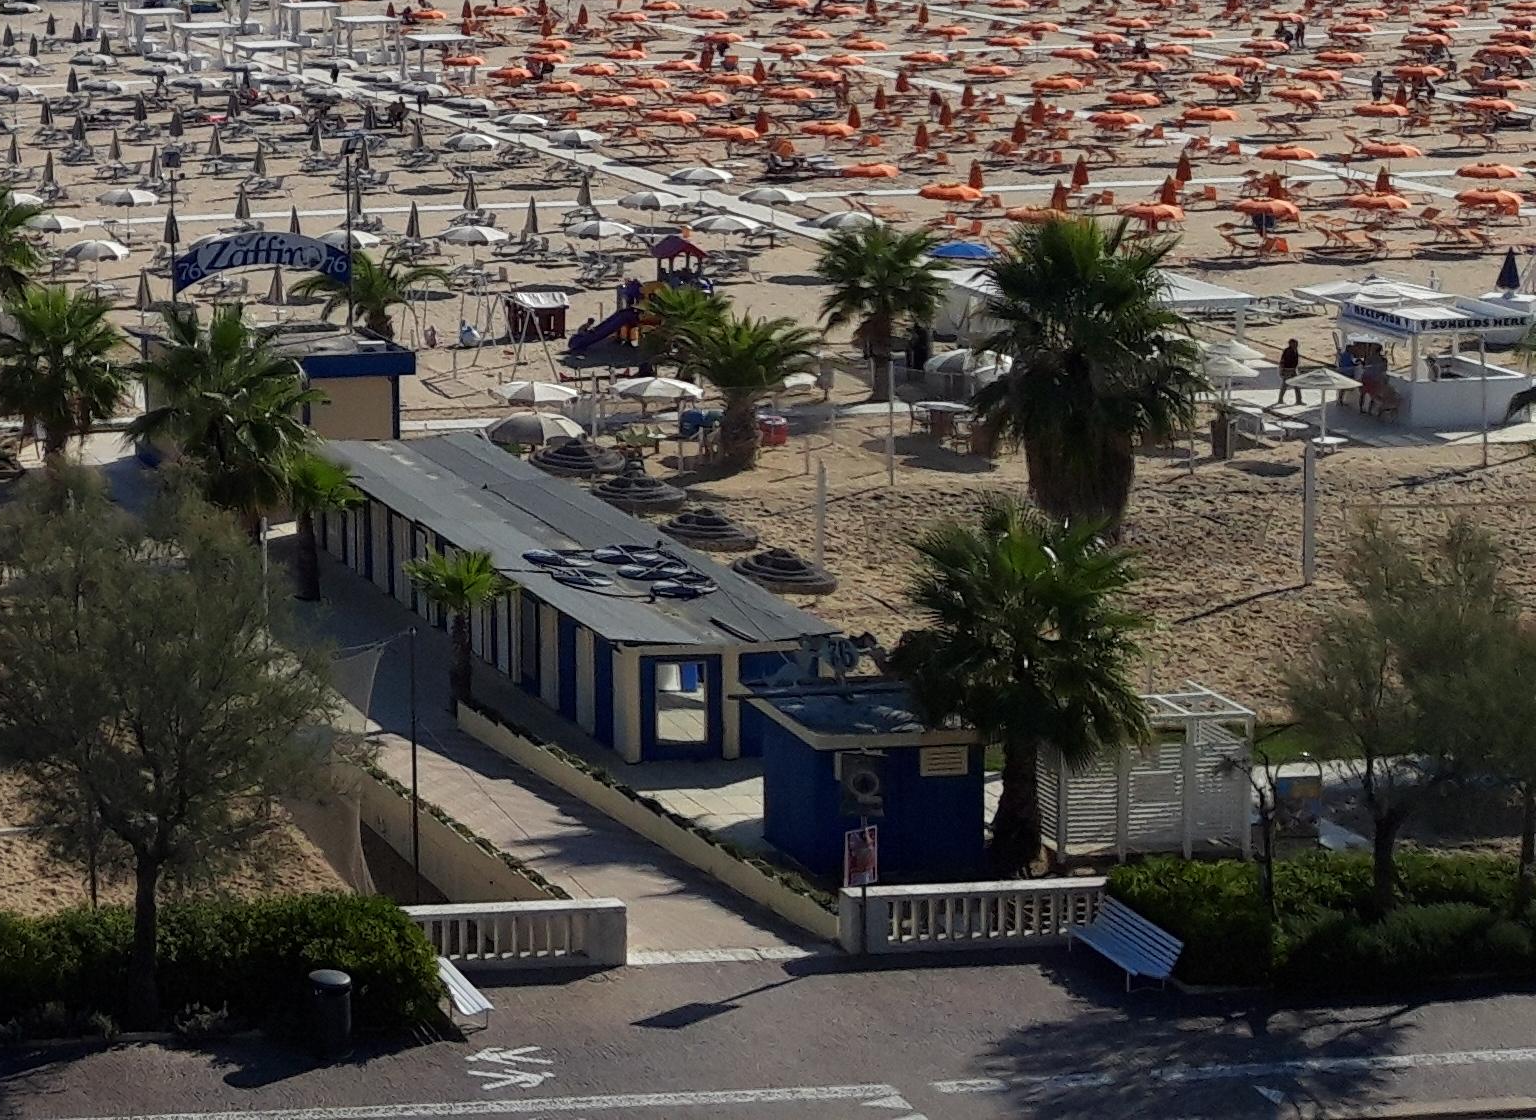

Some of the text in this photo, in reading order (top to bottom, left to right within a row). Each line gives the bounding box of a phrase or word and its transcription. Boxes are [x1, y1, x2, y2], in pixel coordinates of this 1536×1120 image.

[178, 262, 202, 281] 76
[326, 255, 347, 274] 76
[1353, 303, 1402, 327] RECEPTION
[1430, 316, 1528, 330] SUNBEDS HERE
